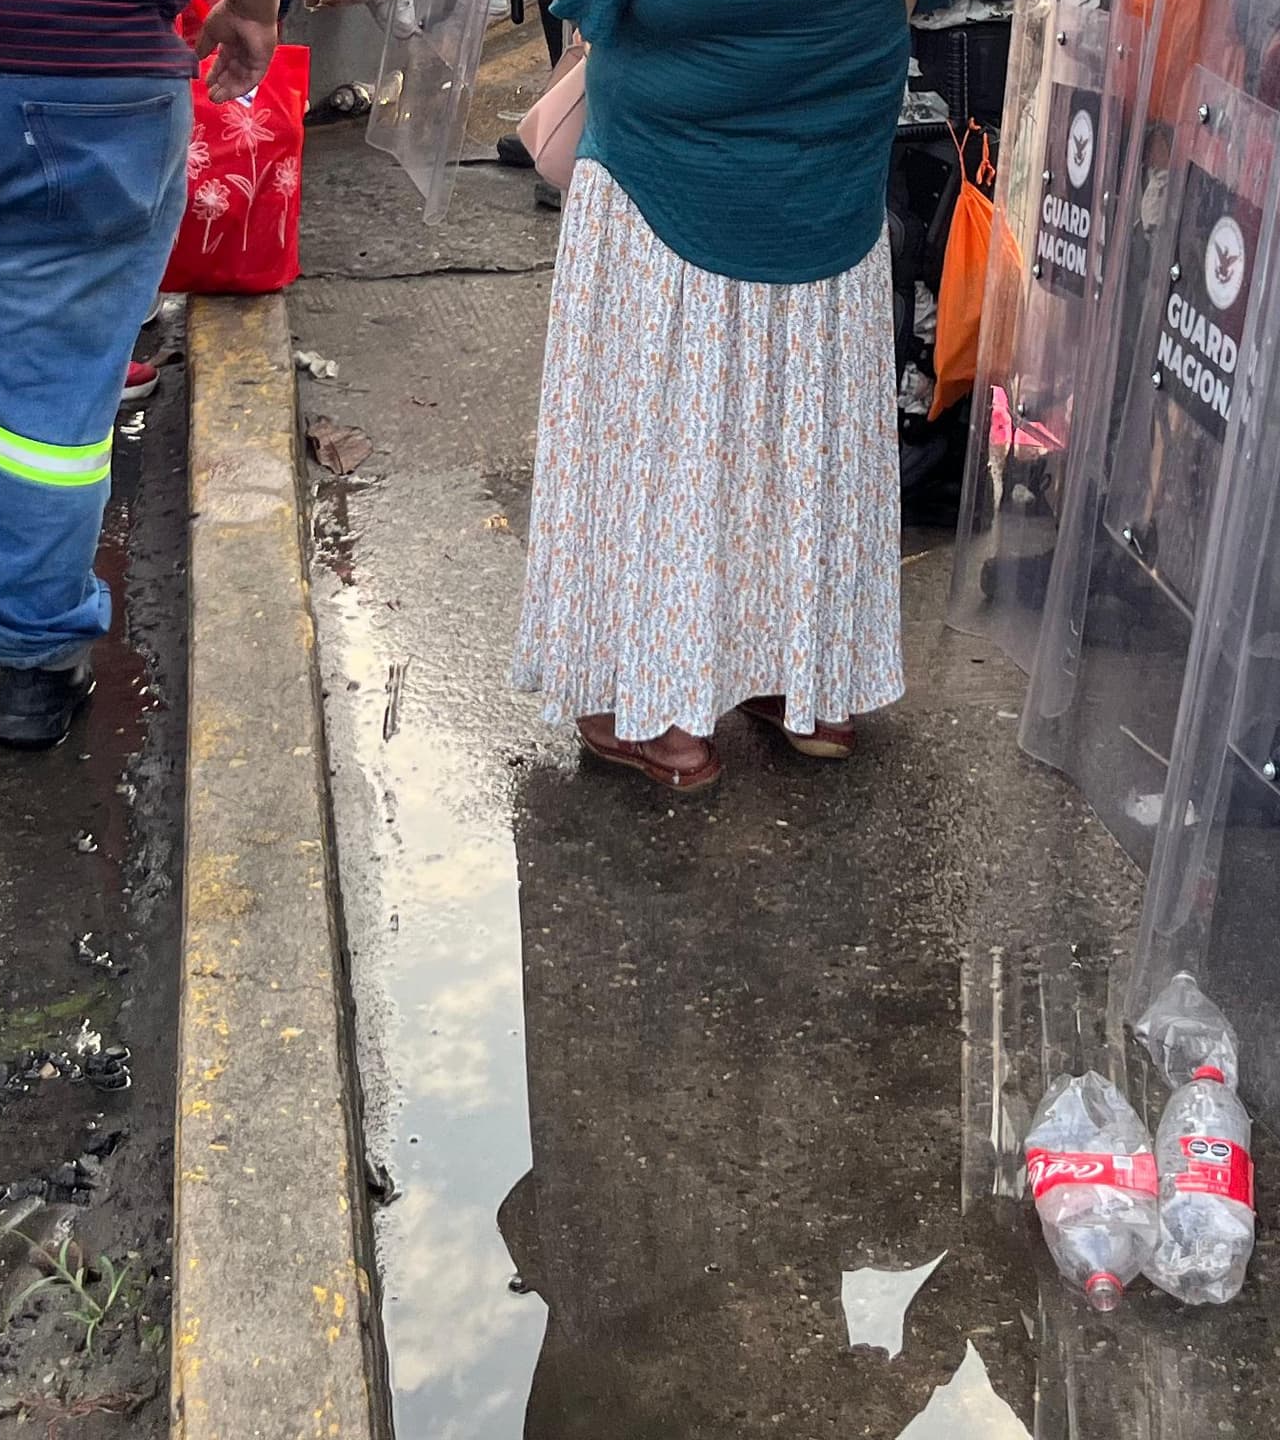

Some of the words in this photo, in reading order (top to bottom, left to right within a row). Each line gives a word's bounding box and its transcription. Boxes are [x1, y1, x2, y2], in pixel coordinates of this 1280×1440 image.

[1043, 194, 1095, 242] GUARD
[1038, 230, 1091, 280] NACION
[1168, 293, 1244, 376] GUARD
[1157, 331, 1238, 422] NACION
